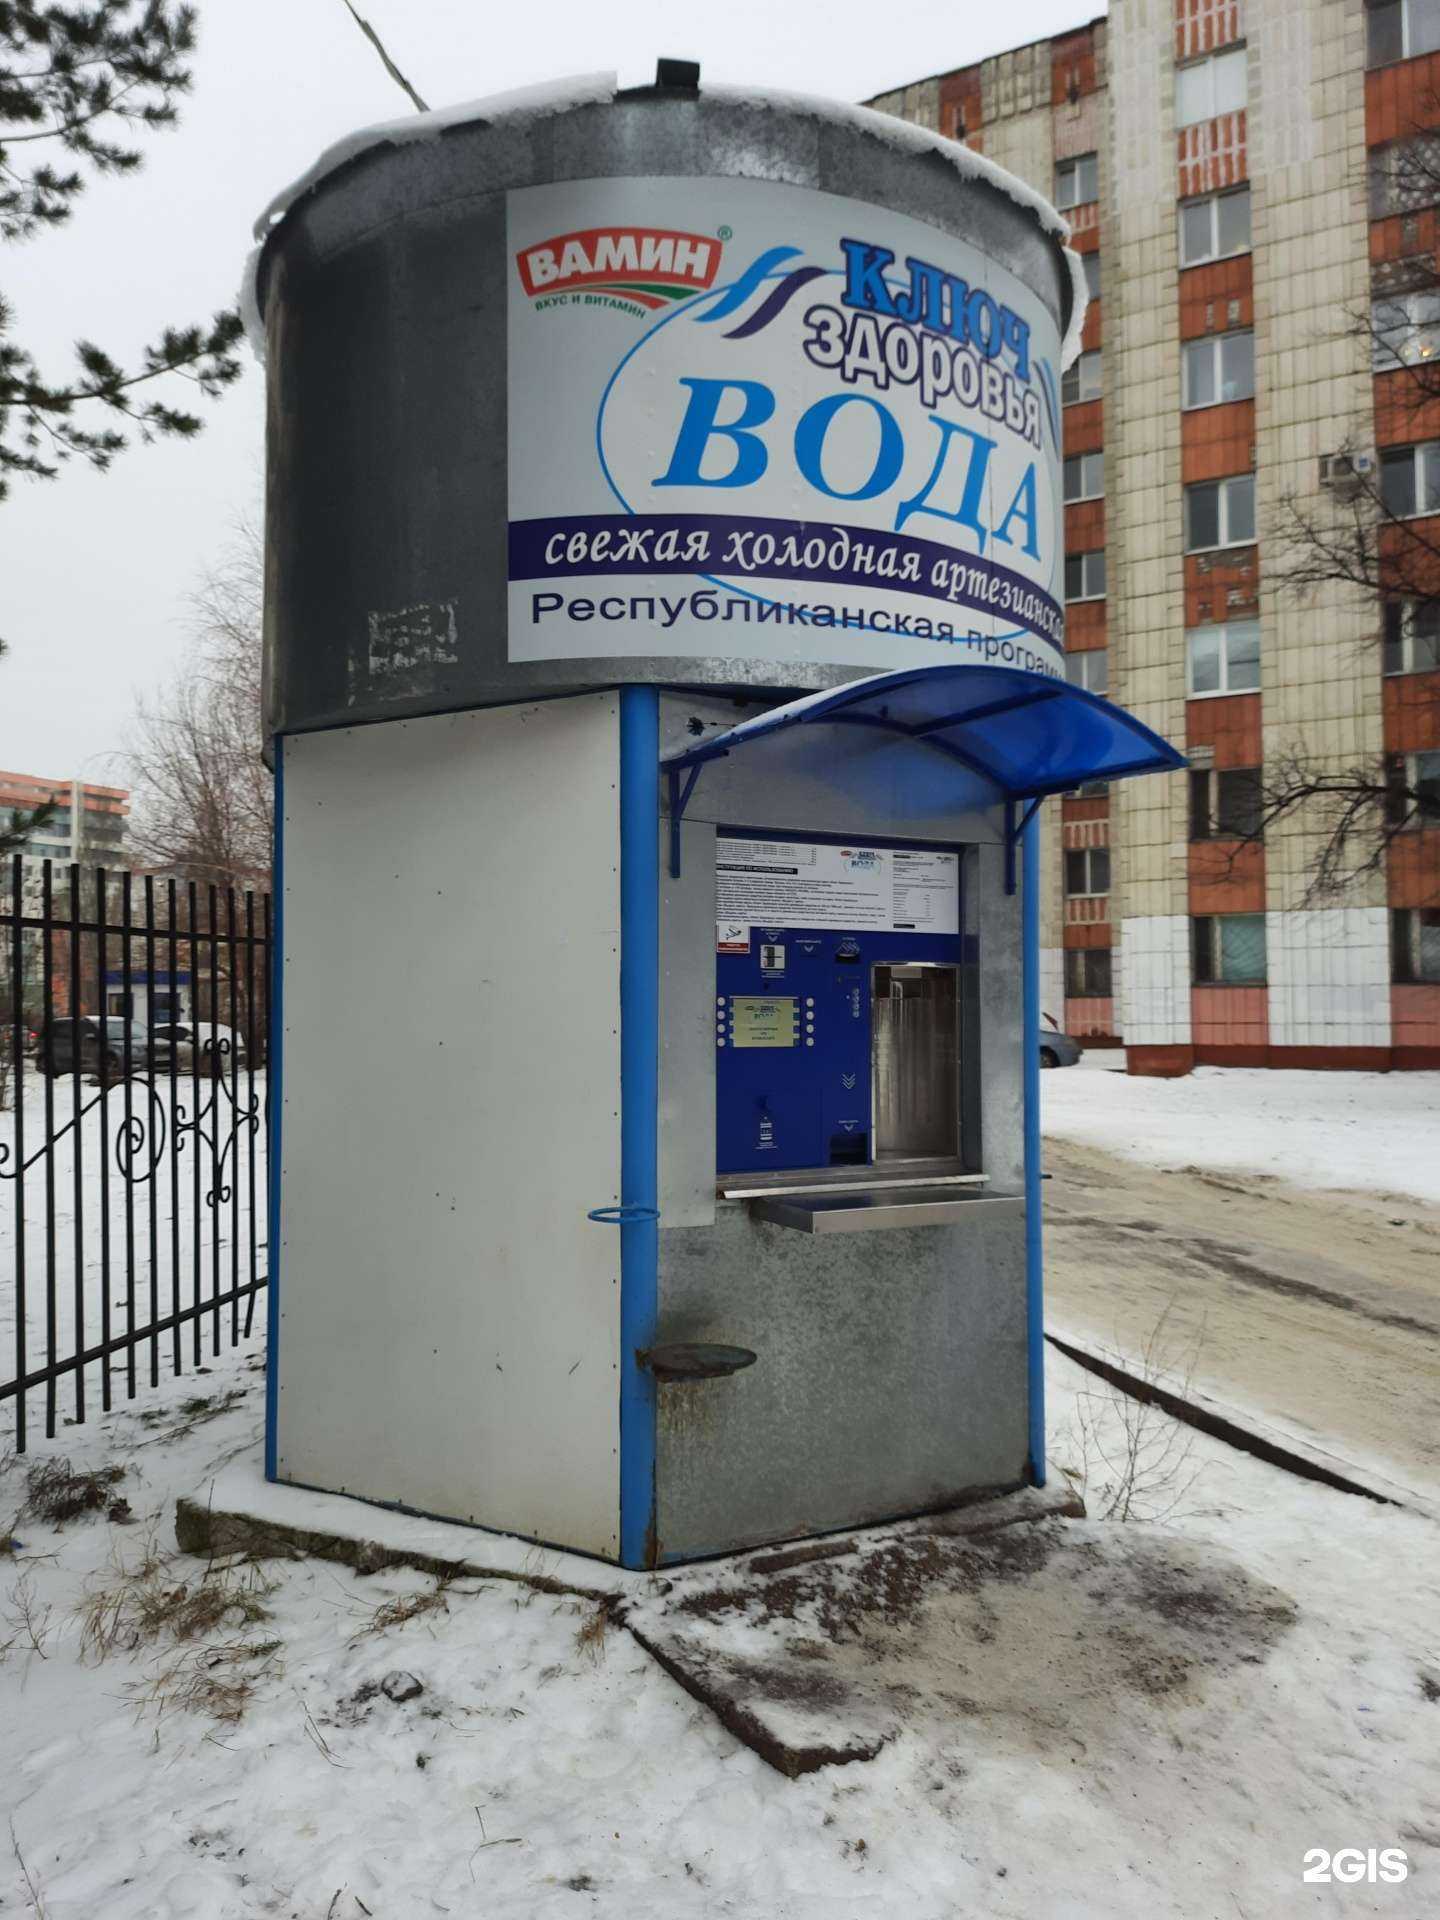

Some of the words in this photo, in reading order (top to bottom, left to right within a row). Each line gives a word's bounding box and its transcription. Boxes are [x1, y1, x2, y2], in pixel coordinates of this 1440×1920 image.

[526, 236, 711, 288] ВАМИН
[535, 295, 568, 312] ВКУС
[571, 295, 582, 305] И
[584, 294, 647, 320] ВИТАМИН
[651, 377, 1041, 562] ВОДА
[545, 528, 710, 565] свежая
[722, 527, 922, 582] холодная
[532, 589, 954, 645] Республиканская
